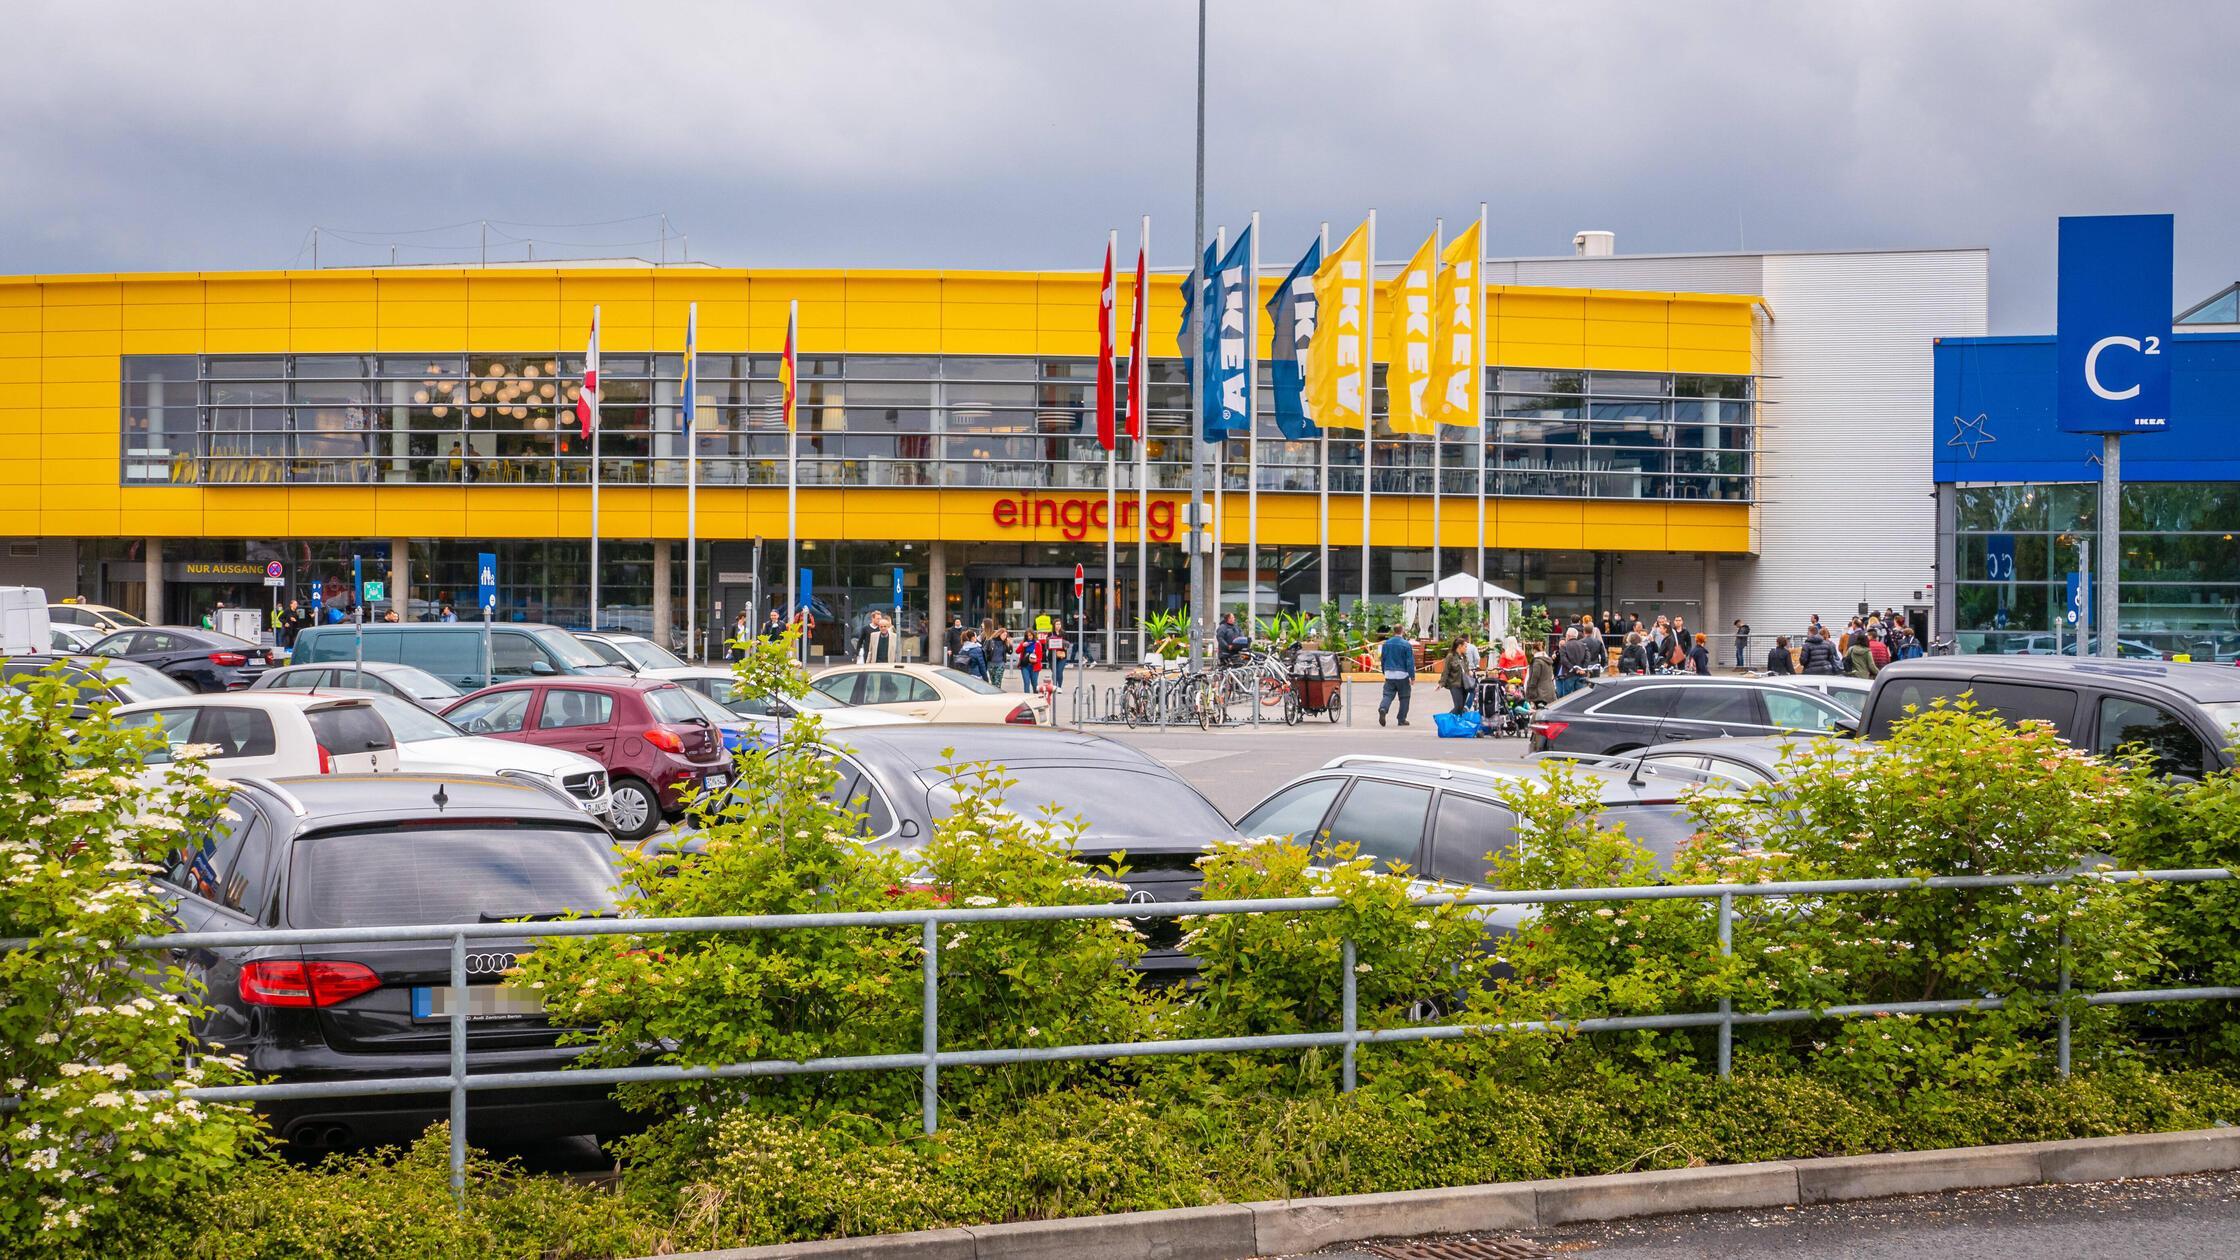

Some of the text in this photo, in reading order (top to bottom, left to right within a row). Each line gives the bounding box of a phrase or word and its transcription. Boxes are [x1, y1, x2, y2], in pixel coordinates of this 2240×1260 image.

[1220, 264, 1246, 417] IKEA
[1336, 260, 1361, 416] IKEA
[1445, 260, 1472, 413] IKEA
[187, 564, 264, 574] NUR AUSGANG
[993, 489, 1175, 542] eingang
